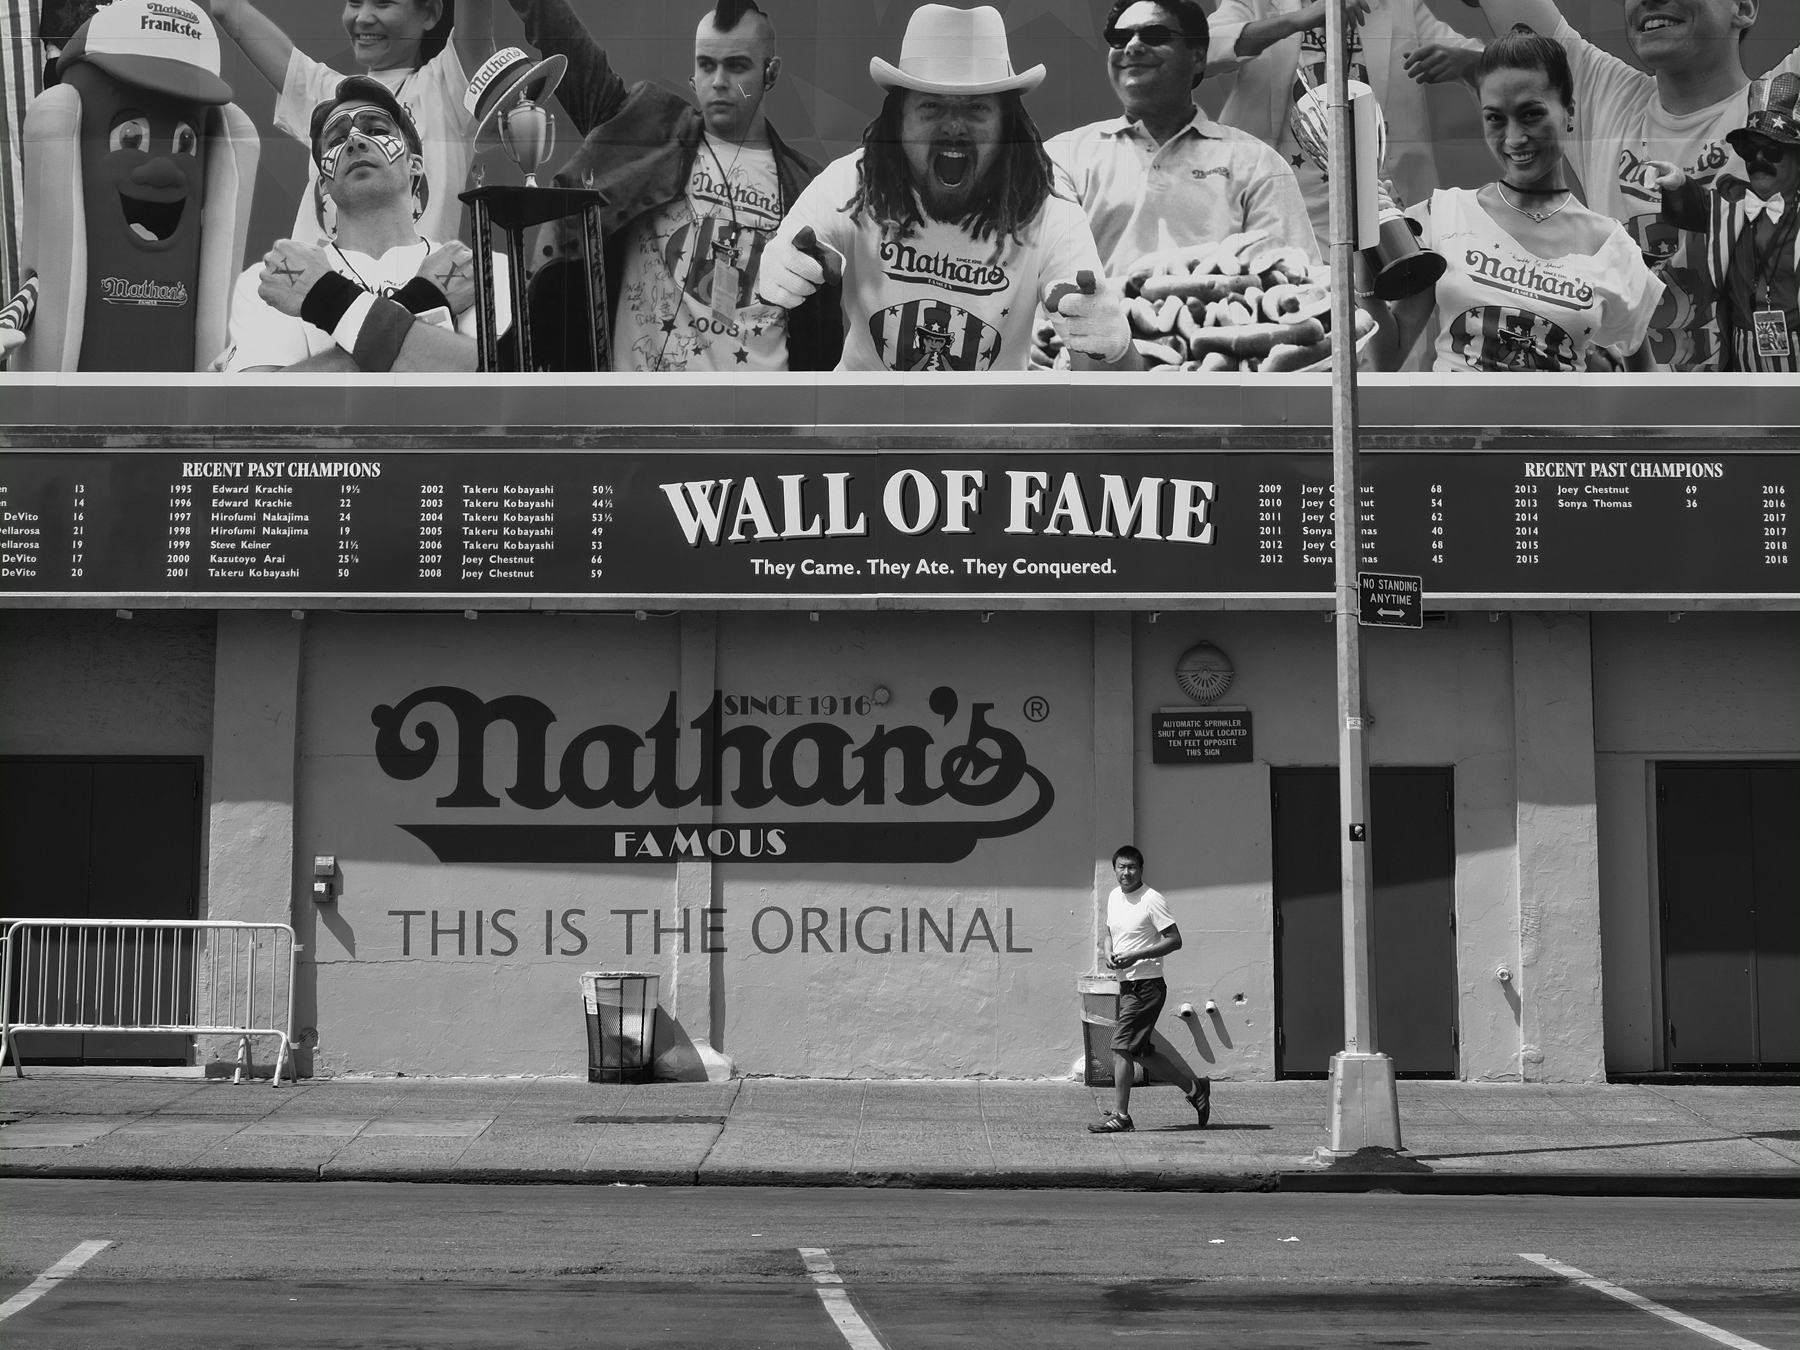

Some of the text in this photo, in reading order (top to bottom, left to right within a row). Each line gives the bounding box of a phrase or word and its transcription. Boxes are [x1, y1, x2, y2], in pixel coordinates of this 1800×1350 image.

[141, 15, 202, 40] Frankster
[1465, 249, 1594, 302] Nathan's
[101, 277, 187, 300] Nathan's
[182, 461, 380, 478] RECENT PAST CHAMPIONS
[1525, 463, 1723, 477] RECENT PAST CHAMPIONS
[75, 484, 85, 494] 13
[170, 484, 293, 494] 1995 Edward Krachie
[420, 484, 554, 496] 2002 Takeru Kobayashi
[1258, 484, 1282, 493] 2009
[1301, 484, 1324, 496] Joey
[1430, 484, 1443, 494] 68
[1514, 484, 1698, 496] 2013 Joey Chestnut 69
[1762, 485, 1785, 495] 2016
[74, 498, 85, 507] 14
[170, 498, 351, 508] 1996 Edward Krachie 22
[659, 468, 1215, 545] WALL OF FAME
[1259, 498, 1282, 507] 2010
[1301, 498, 1324, 510] Joey
[1431, 498, 1443, 508] 54
[1514, 498, 1698, 510] 2013 Sonya Thomas 36
[3, 512, 84, 521] DeVito 16
[169, 512, 351, 524] 1997 Hirofumi Nakajima 24
[1259, 512, 1281, 521] 2011
[1301, 512, 1325, 524] Joey
[1431, 512, 1443, 522] 62
[1515, 512, 1539, 522] 2014
[1763, 513, 1786, 522] 2017
[73, 526, 84, 535] 21
[72, 540, 83, 549] 19
[168, 540, 272, 550] 1999 Steve Keiner
[1259, 540, 1283, 549] 2012
[1302, 540, 1325, 552] Joey
[1431, 540, 1444, 550] 68
[1515, 540, 1539, 550] 2015
[1764, 541, 1788, 550] 2018
[2, 553, 83, 563] DeVito 17
[167, 554, 286, 566] 2000 Kazutoyo Arai
[419, 554, 603, 566] 2007 Joey Chestnut 66
[1260, 554, 1444, 566] 2012 Sonya 45
[1, 567, 83, 577] DeVito 20
[166, 568, 350, 580] 2001 Takeru Kobayashi 50
[419, 568, 603, 580] 2008 Joey Chestnut 59
[751, 559, 1116, 579] They Came. They Ate. They Conquered.
[1362, 577, 1418, 593] NO STANDING
[1369, 593, 1413, 606] ANYTIME
[724, 694, 871, 716] SINCE 1916
[1162, 719, 1242, 728] AUTOMATIC SPRINKLER
[1157, 730, 1175, 738] SHUT
[1178, 730, 1191, 738] OFF
[1194, 729, 1215, 737] VALVE
[1204, 738, 1237, 746] OPPOSITE
[371, 685, 1055, 812] Nathan's
[1204, 748, 1220, 756] SIGN
[613, 827, 787, 858] FAMOUS
[388, 905, 1033, 956] THIS IS THE ORIGINAL
